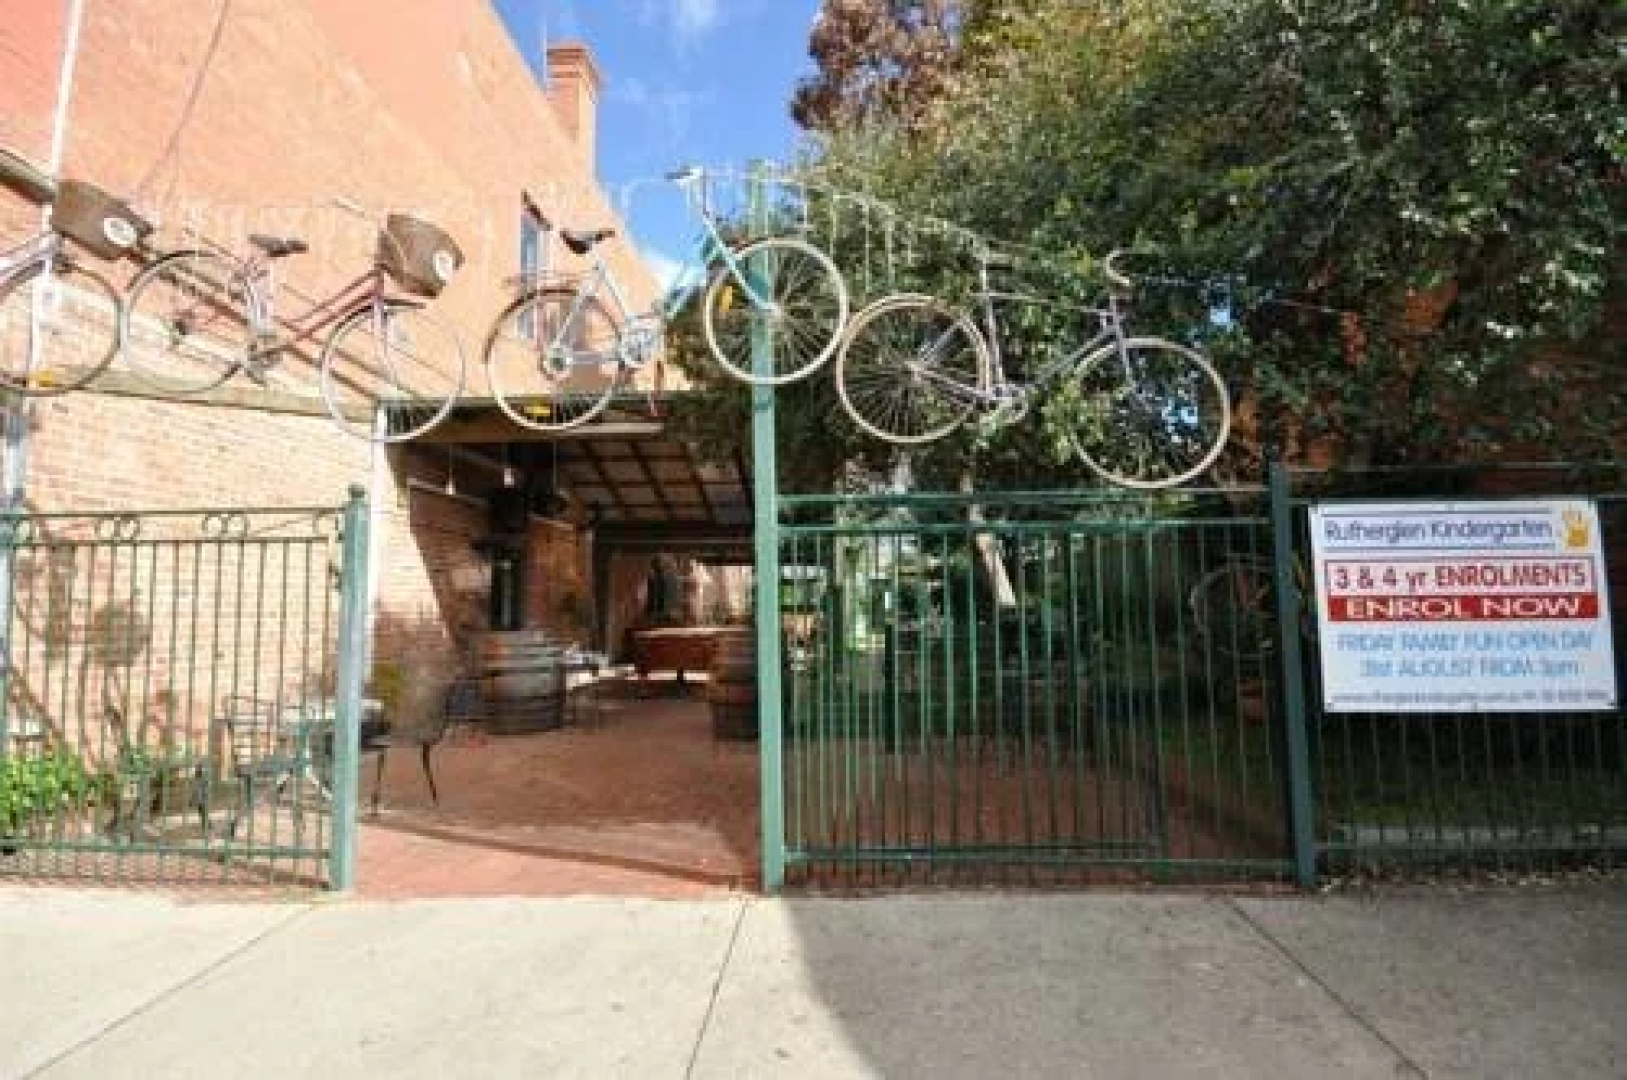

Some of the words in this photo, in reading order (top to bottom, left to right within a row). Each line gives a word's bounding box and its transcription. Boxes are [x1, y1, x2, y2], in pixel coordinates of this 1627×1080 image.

[1325, 520, 1426, 543] Rutherglen
[1431, 520, 1553, 543] Kindergarten
[1336, 566, 1350, 589] 3
[1356, 565, 1374, 589] &
[1383, 565, 1398, 587] 4
[1434, 562, 1586, 587] ENROLMENTS
[1347, 598, 1466, 619] ENROL
[1482, 596, 1580, 617] NOW
